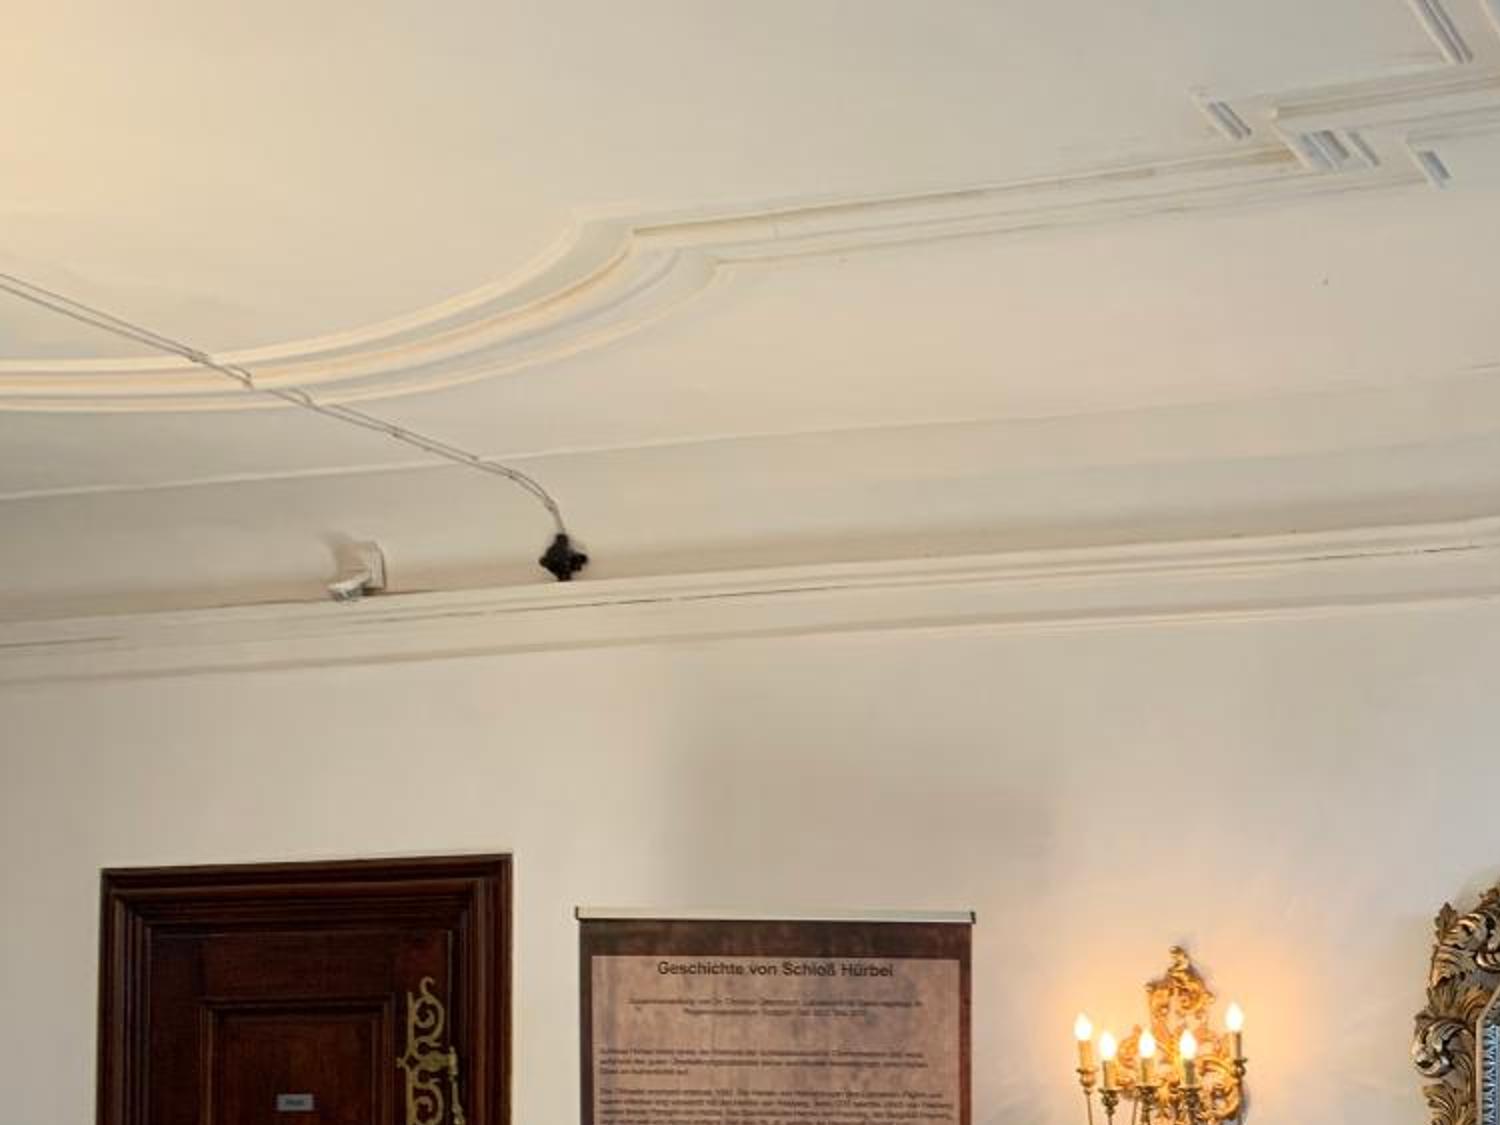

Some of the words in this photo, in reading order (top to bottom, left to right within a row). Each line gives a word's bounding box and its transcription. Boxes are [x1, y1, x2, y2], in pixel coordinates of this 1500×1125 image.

[657, 961, 743, 976] Geschichte
[750, 965, 777, 976] von
[782, 961, 835, 977] Schloß
[841, 963, 894, 977] Hürbel
